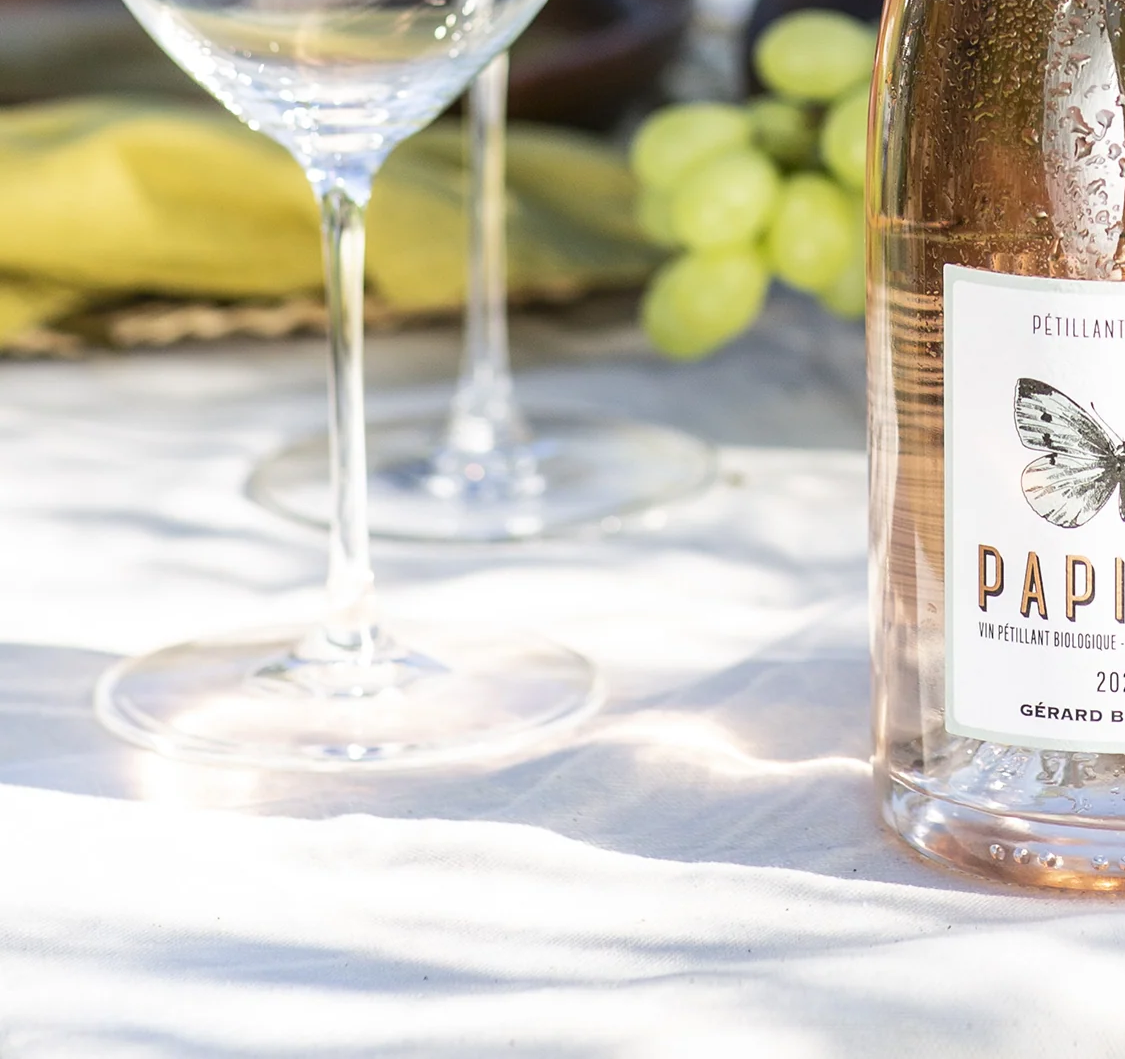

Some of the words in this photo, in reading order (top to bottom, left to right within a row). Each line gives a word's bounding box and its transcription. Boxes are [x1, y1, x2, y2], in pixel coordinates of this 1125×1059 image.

[1032, 312, 1124, 339] PÉTILLANT
[978, 621, 995, 640] VIN
[997, 622, 1051, 647] PÉTILLANT
[1053, 630, 1117, 652] BIOLOGIQUE
[1019, 701, 1103, 723] GÉRARD
